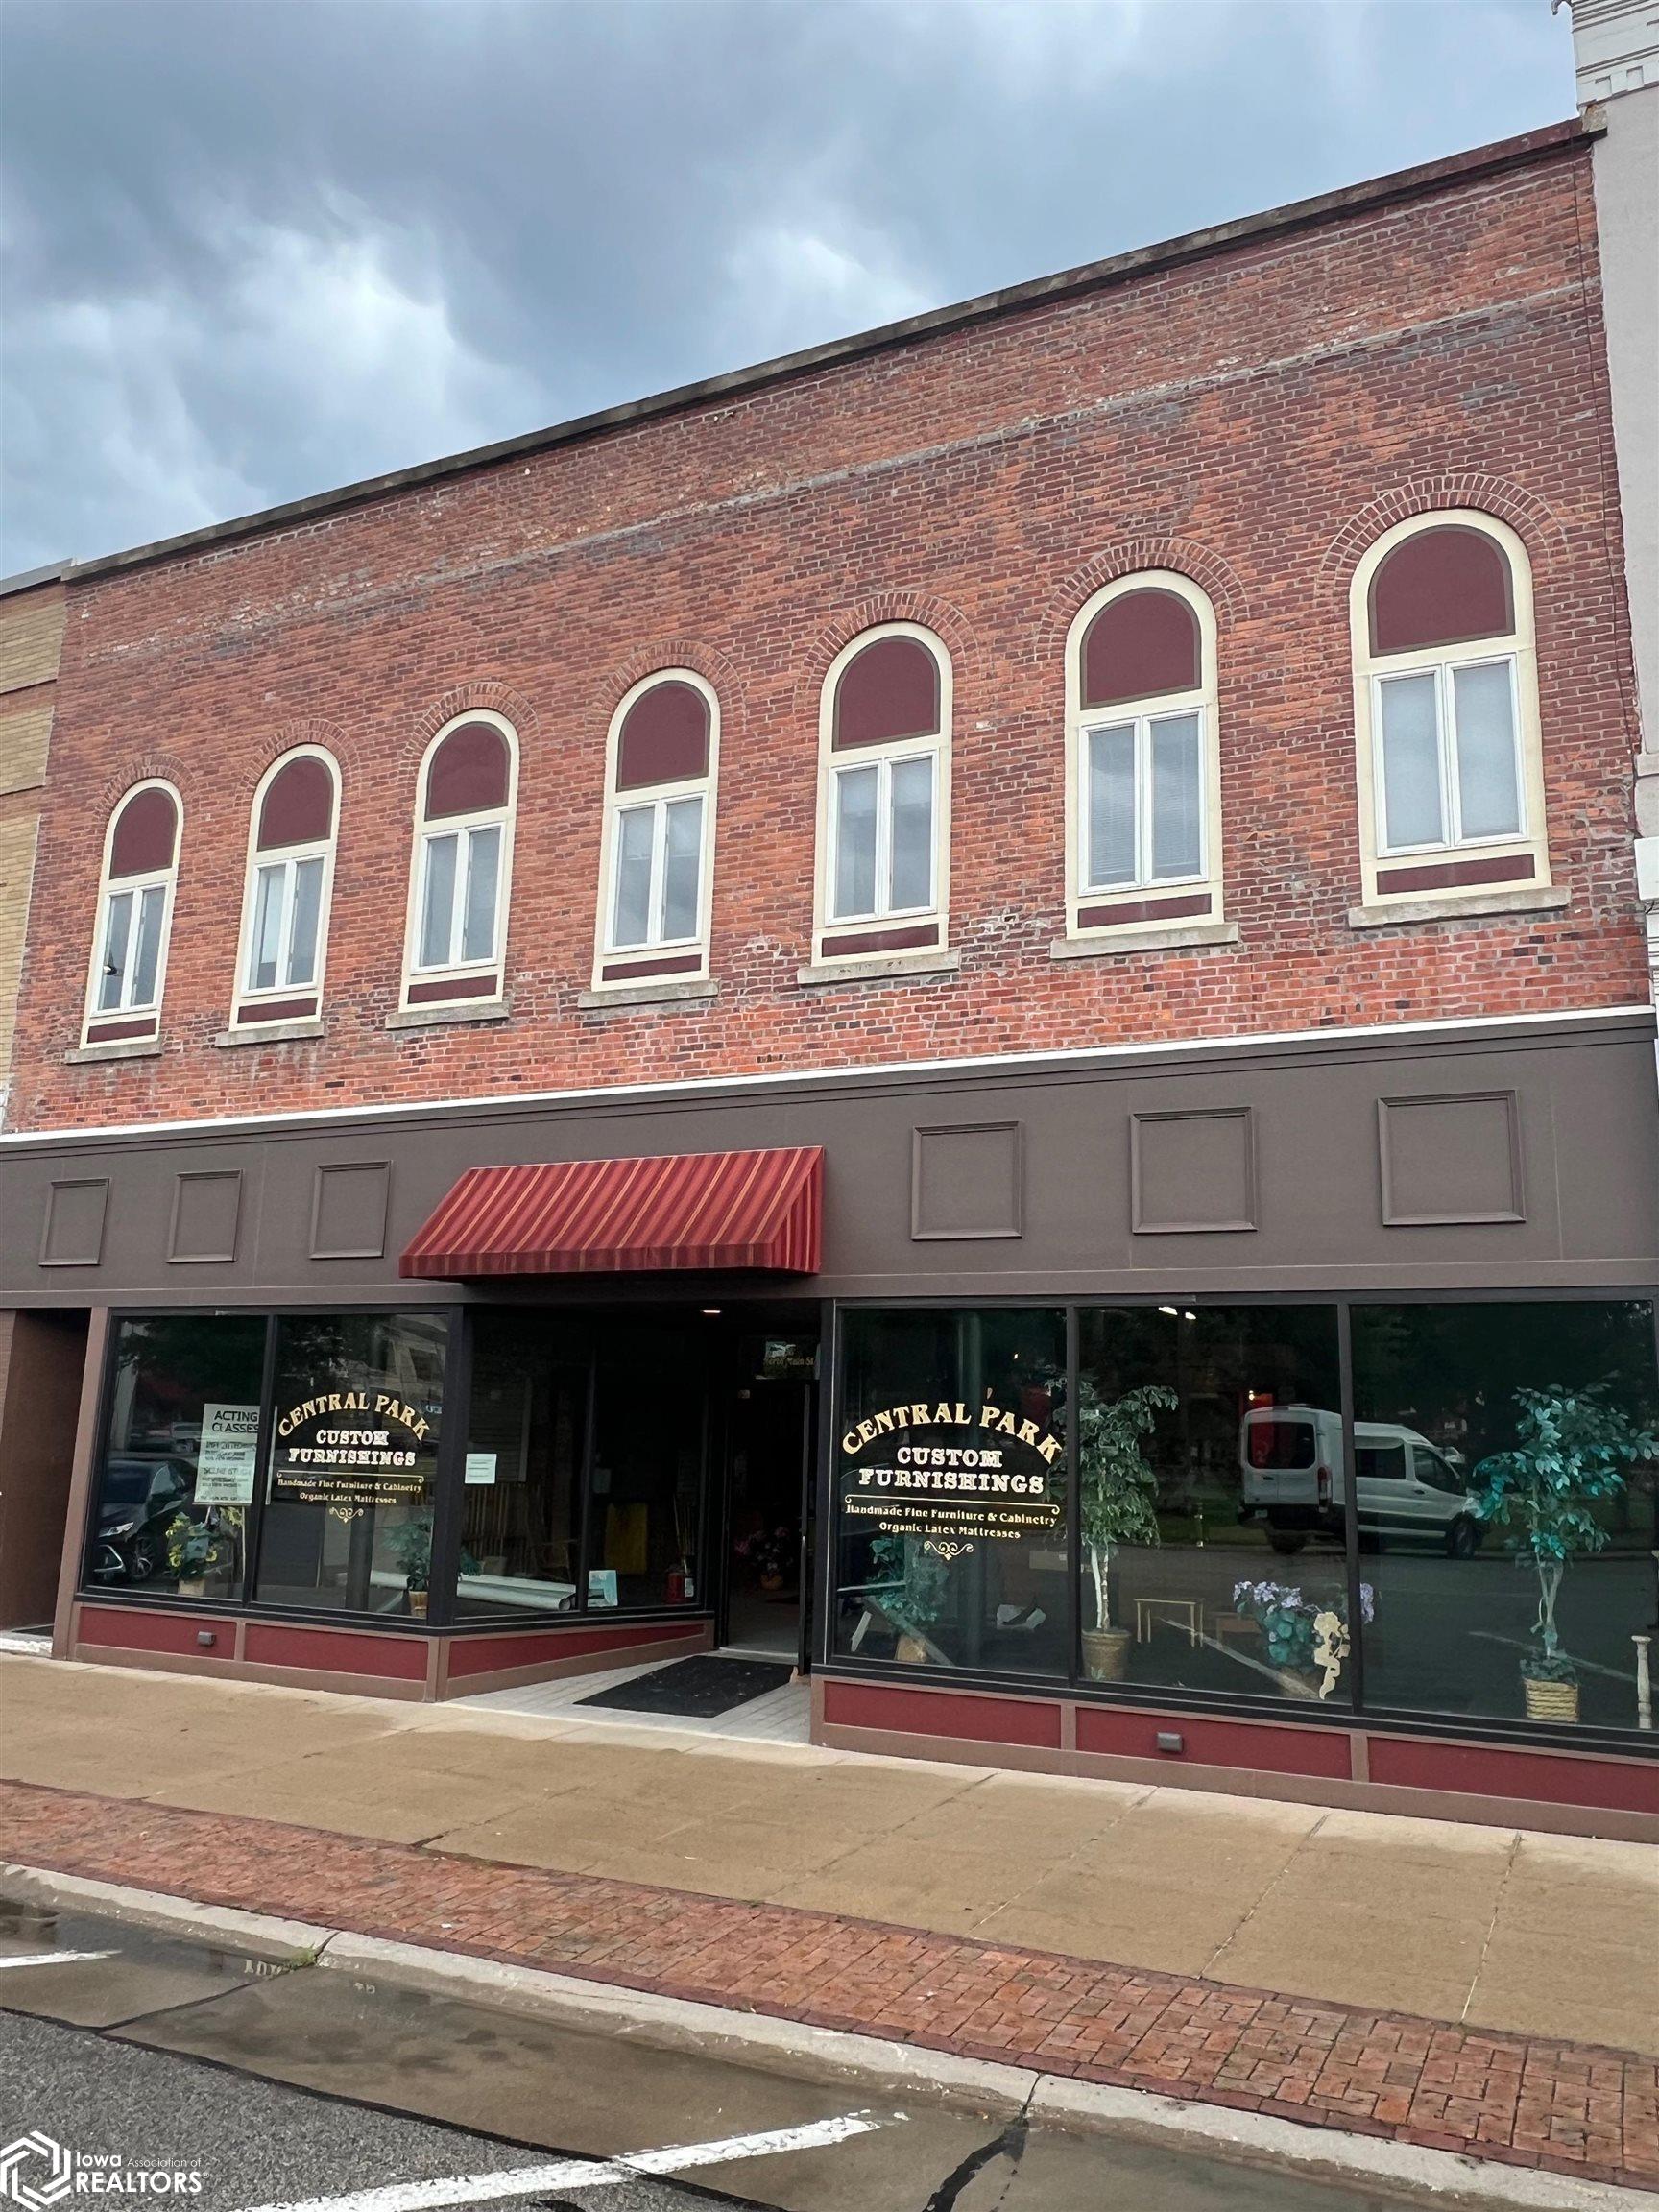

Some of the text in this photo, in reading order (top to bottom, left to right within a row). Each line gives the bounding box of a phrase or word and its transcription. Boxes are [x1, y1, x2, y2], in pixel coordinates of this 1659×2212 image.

[214, 1410, 258, 1422] ACTING
[278, 1392, 430, 1441] CENTRAL PARK
[316, 1430, 389, 1446] CUSTOM
[842, 1402, 1063, 1464] CENTRAL PARK
[288, 1448, 417, 1466] FURNISHINGS
[897, 1447, 1003, 1468] CUSTOM
[277, 1479, 317, 1488] Handmade
[336, 1481, 373, 1490] Furniture
[383, 1483, 422, 1493] Cabinetry
[858, 1468, 1044, 1494] FURNISHINGS
[300, 1492, 397, 1503] Organic Latex Mattresses
[846, 1504, 1057, 1527] Handmade Fine Furniture & Cabinetry
[879, 1522, 1021, 1539] Organic Latex Mattresses
